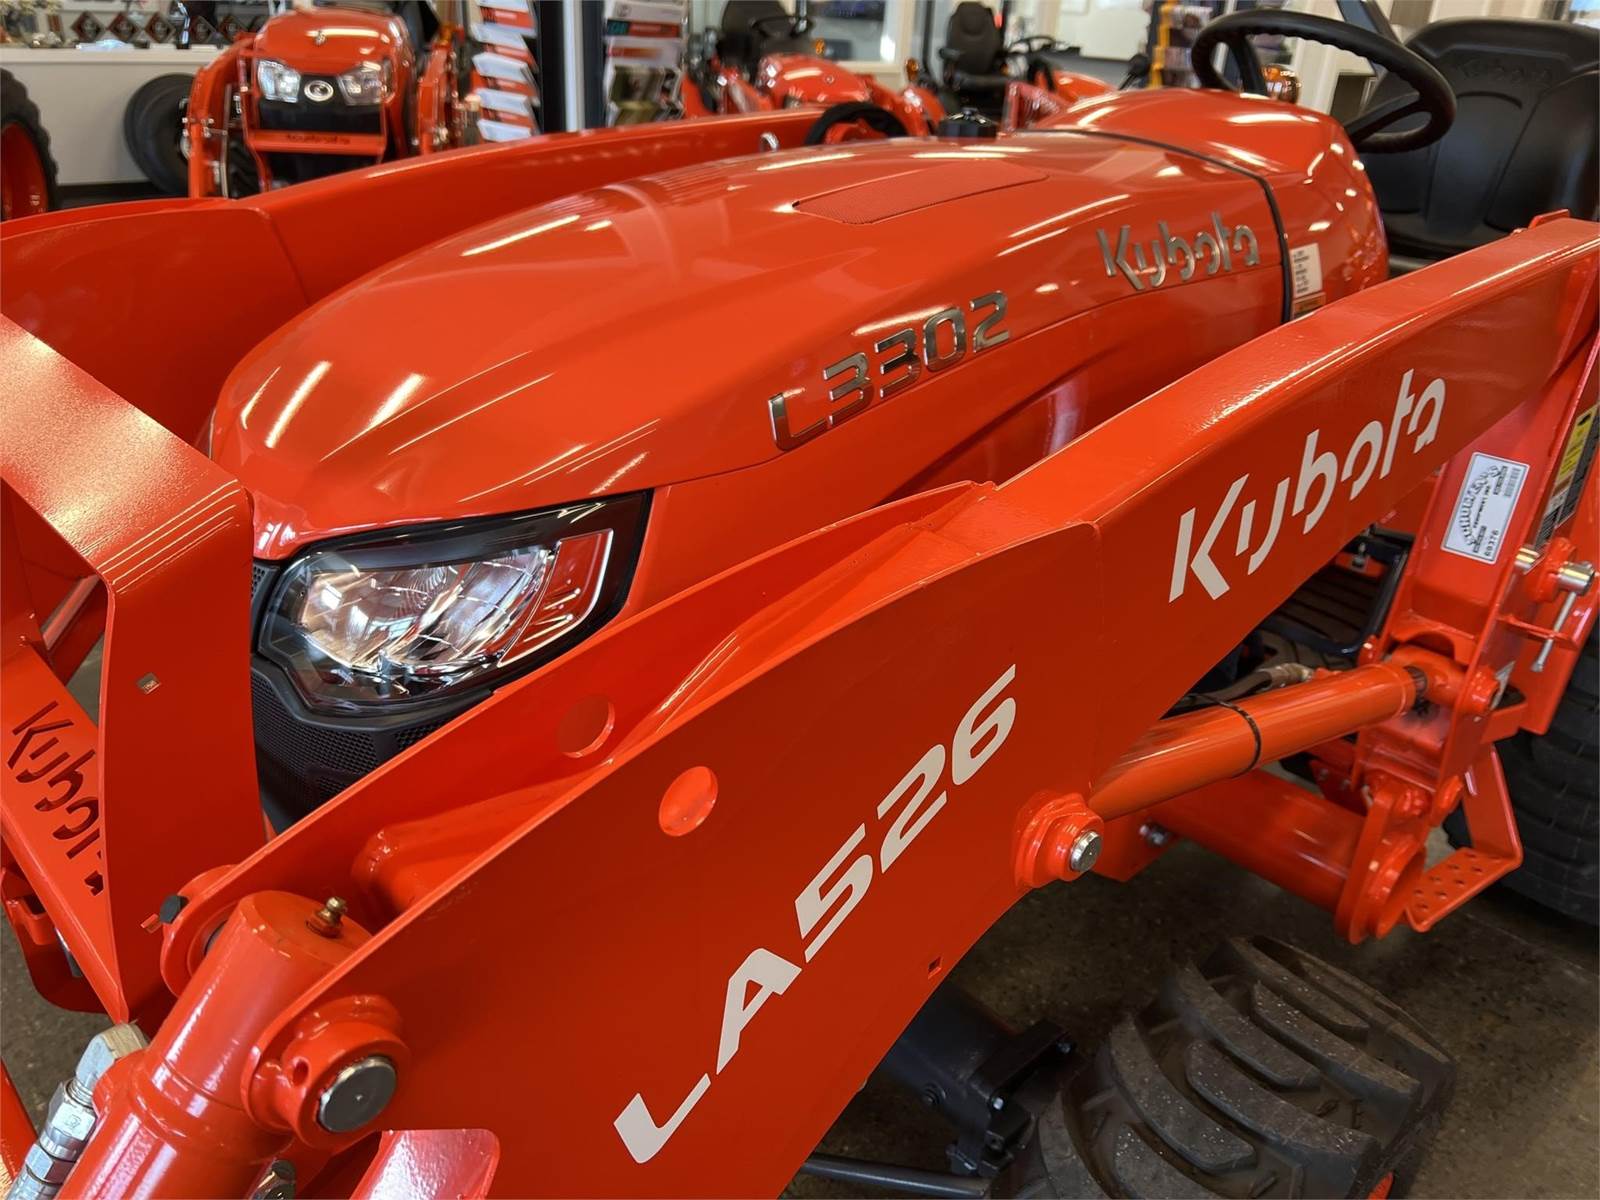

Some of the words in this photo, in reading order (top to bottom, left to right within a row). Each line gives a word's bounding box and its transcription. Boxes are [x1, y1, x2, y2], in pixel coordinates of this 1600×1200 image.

[1096, 210, 1260, 291] Kubota
[768, 290, 1010, 452] L3302
[1169, 368, 1447, 604] Kubota
[613, 663, 1016, 1164] LA526
